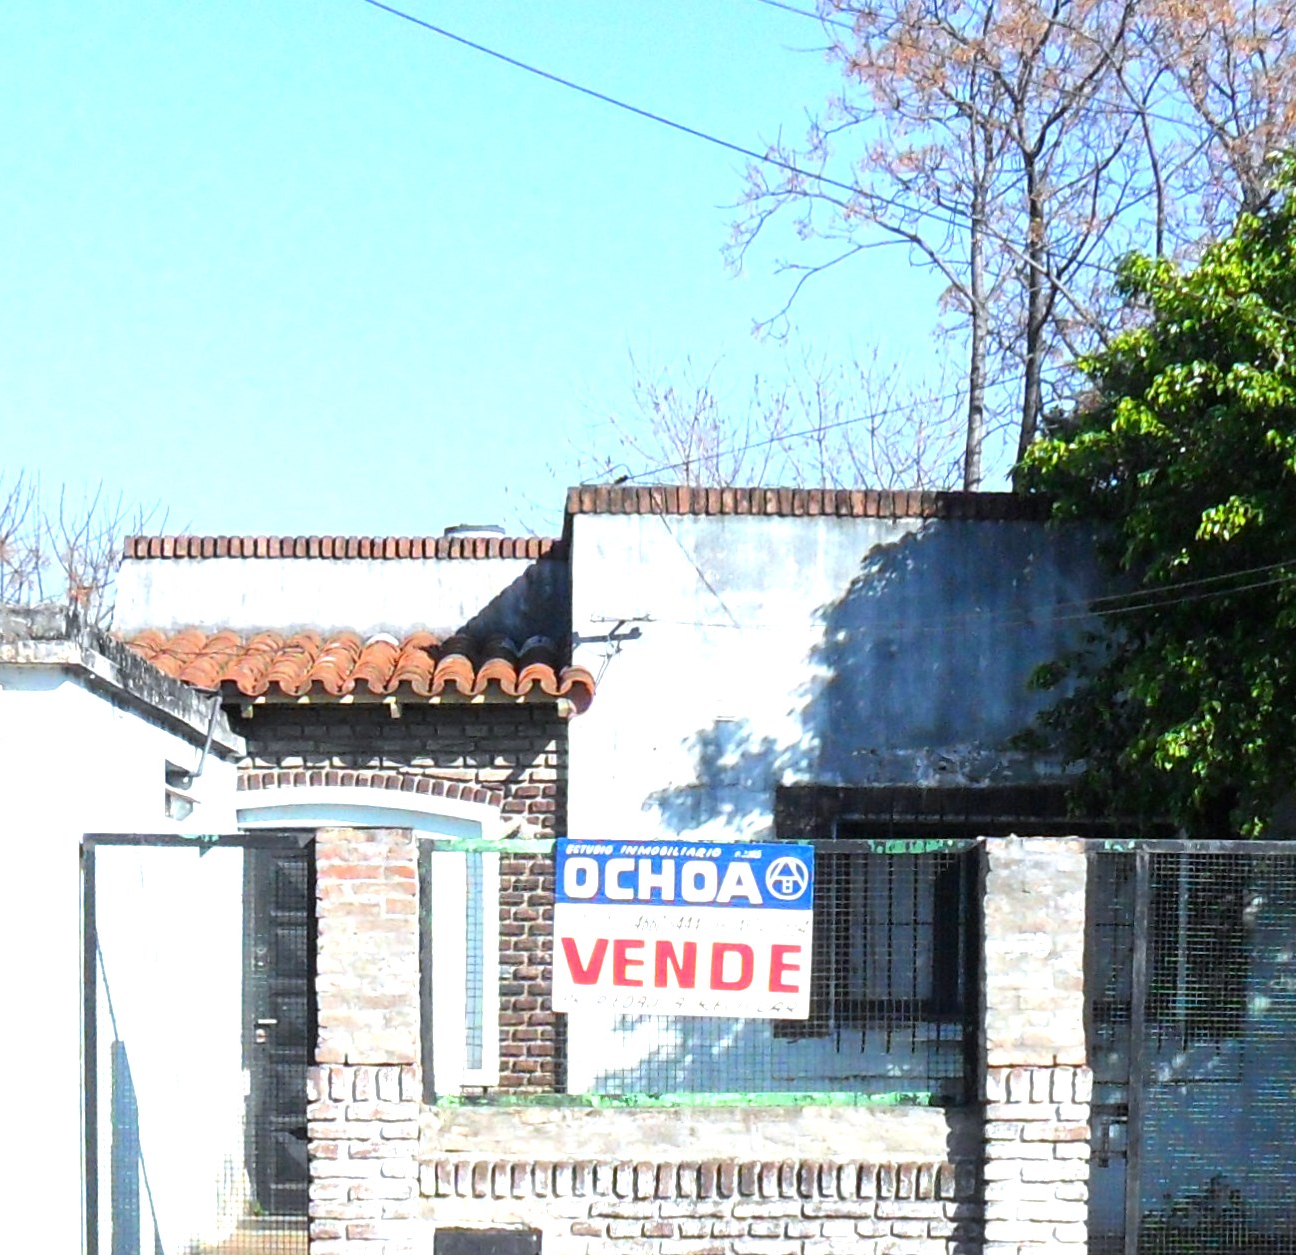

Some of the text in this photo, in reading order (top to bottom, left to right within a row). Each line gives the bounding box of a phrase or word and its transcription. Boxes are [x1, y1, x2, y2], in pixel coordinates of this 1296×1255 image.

[565, 843, 614, 856] ESTUDIO
[620, 845, 722, 858] INMOBILIARIO
[563, 856, 764, 905] OCHOA
[560, 936, 802, 994] VENDE
